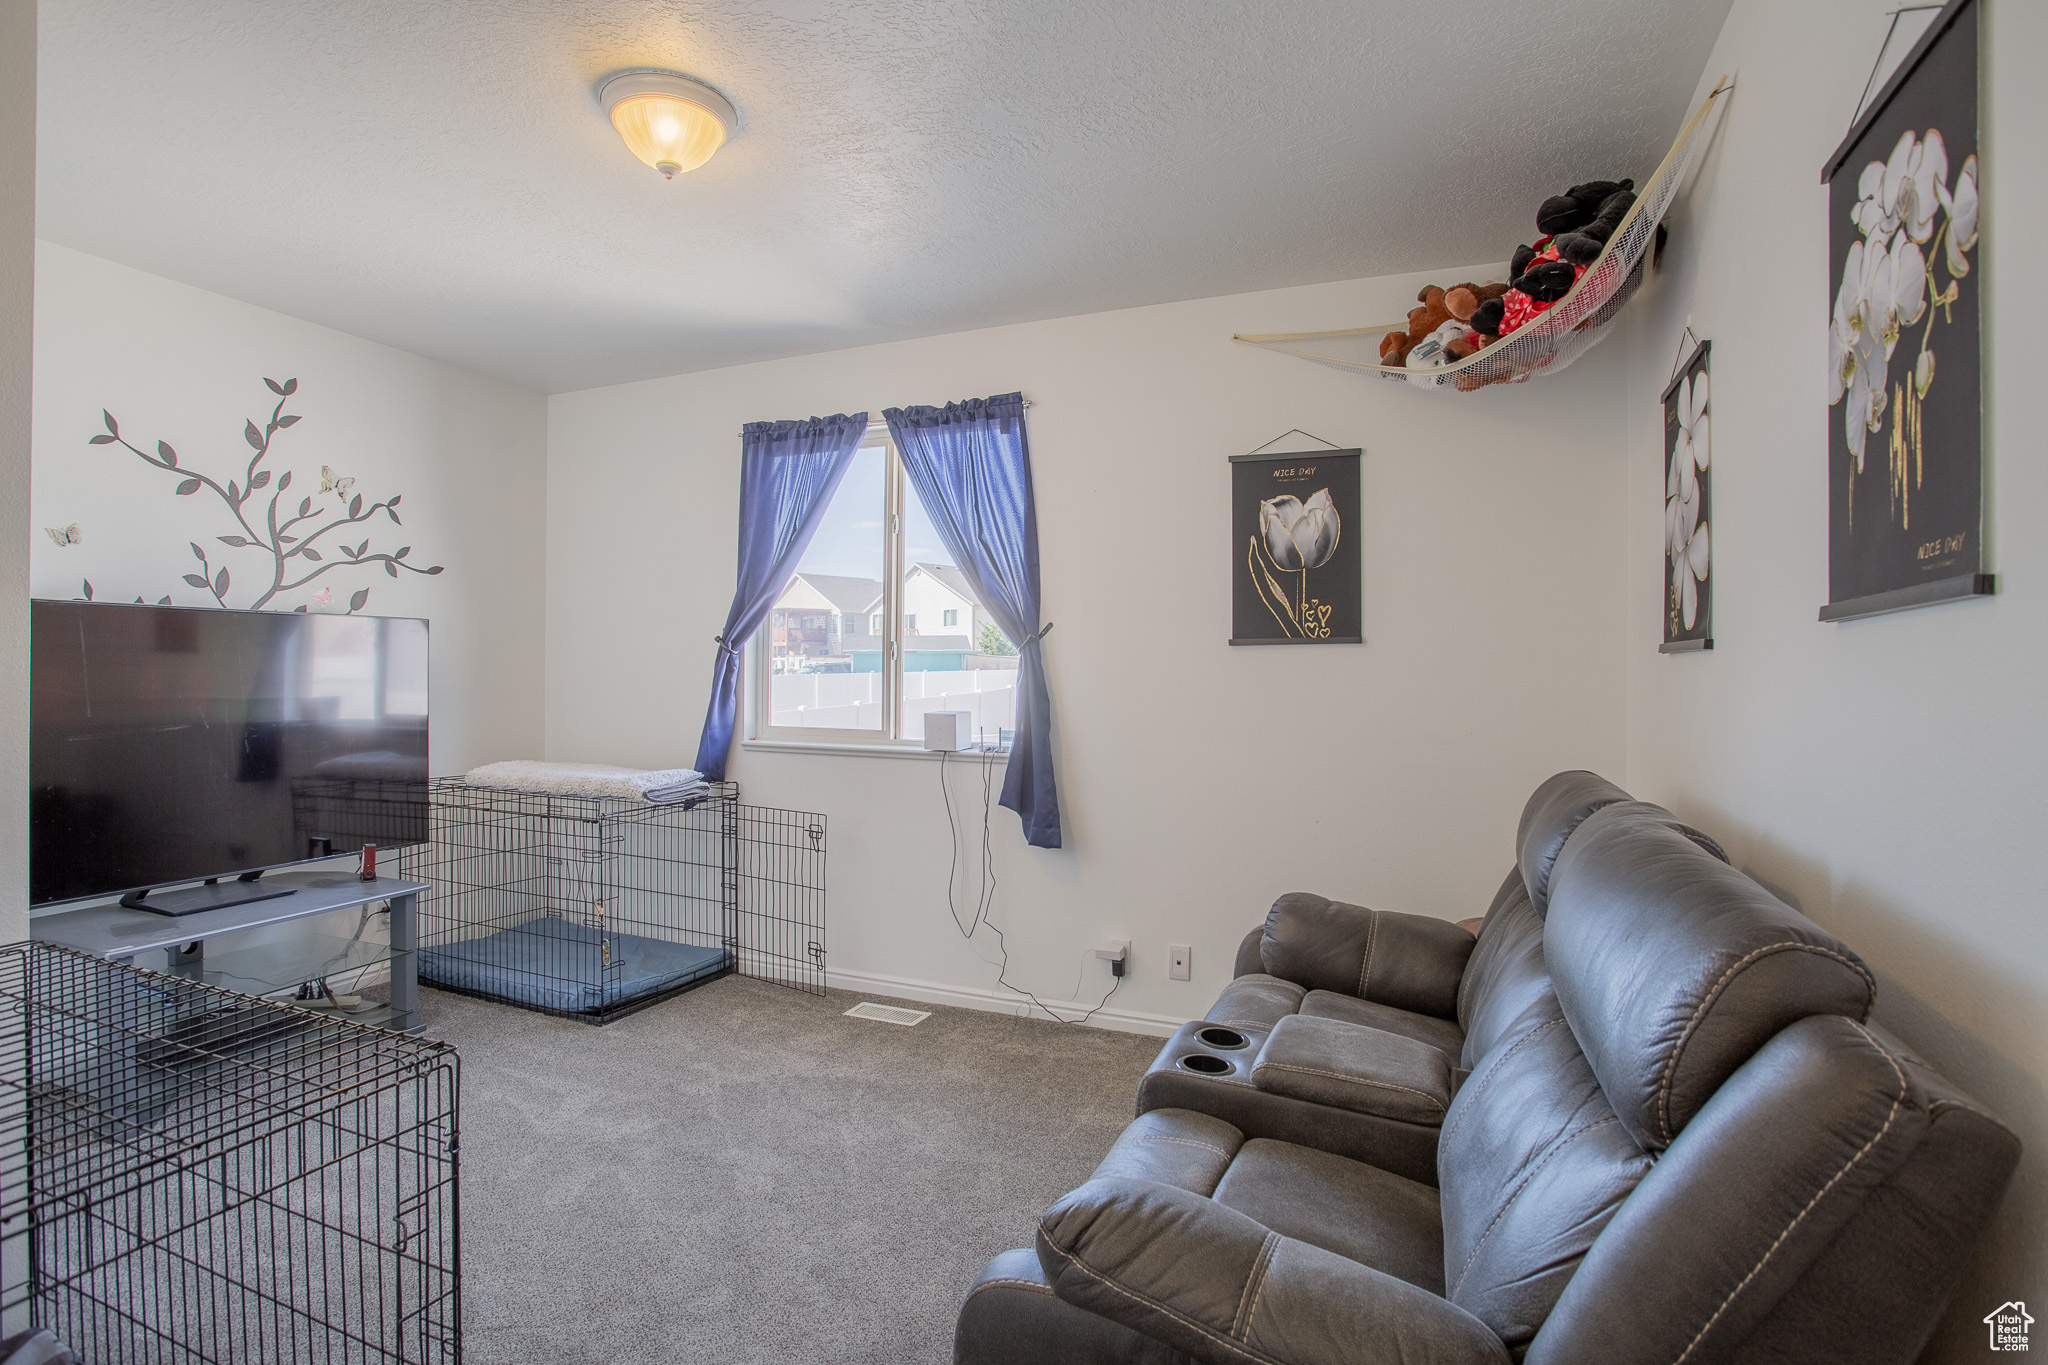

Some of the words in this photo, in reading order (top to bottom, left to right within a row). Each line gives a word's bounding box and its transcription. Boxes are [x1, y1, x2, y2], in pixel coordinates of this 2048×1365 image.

[1273, 468, 1296, 477] NICE
[1299, 466, 1316, 475] DAY
[1917, 540, 1941, 559] NICE
[1944, 532, 1966, 552] DAY
